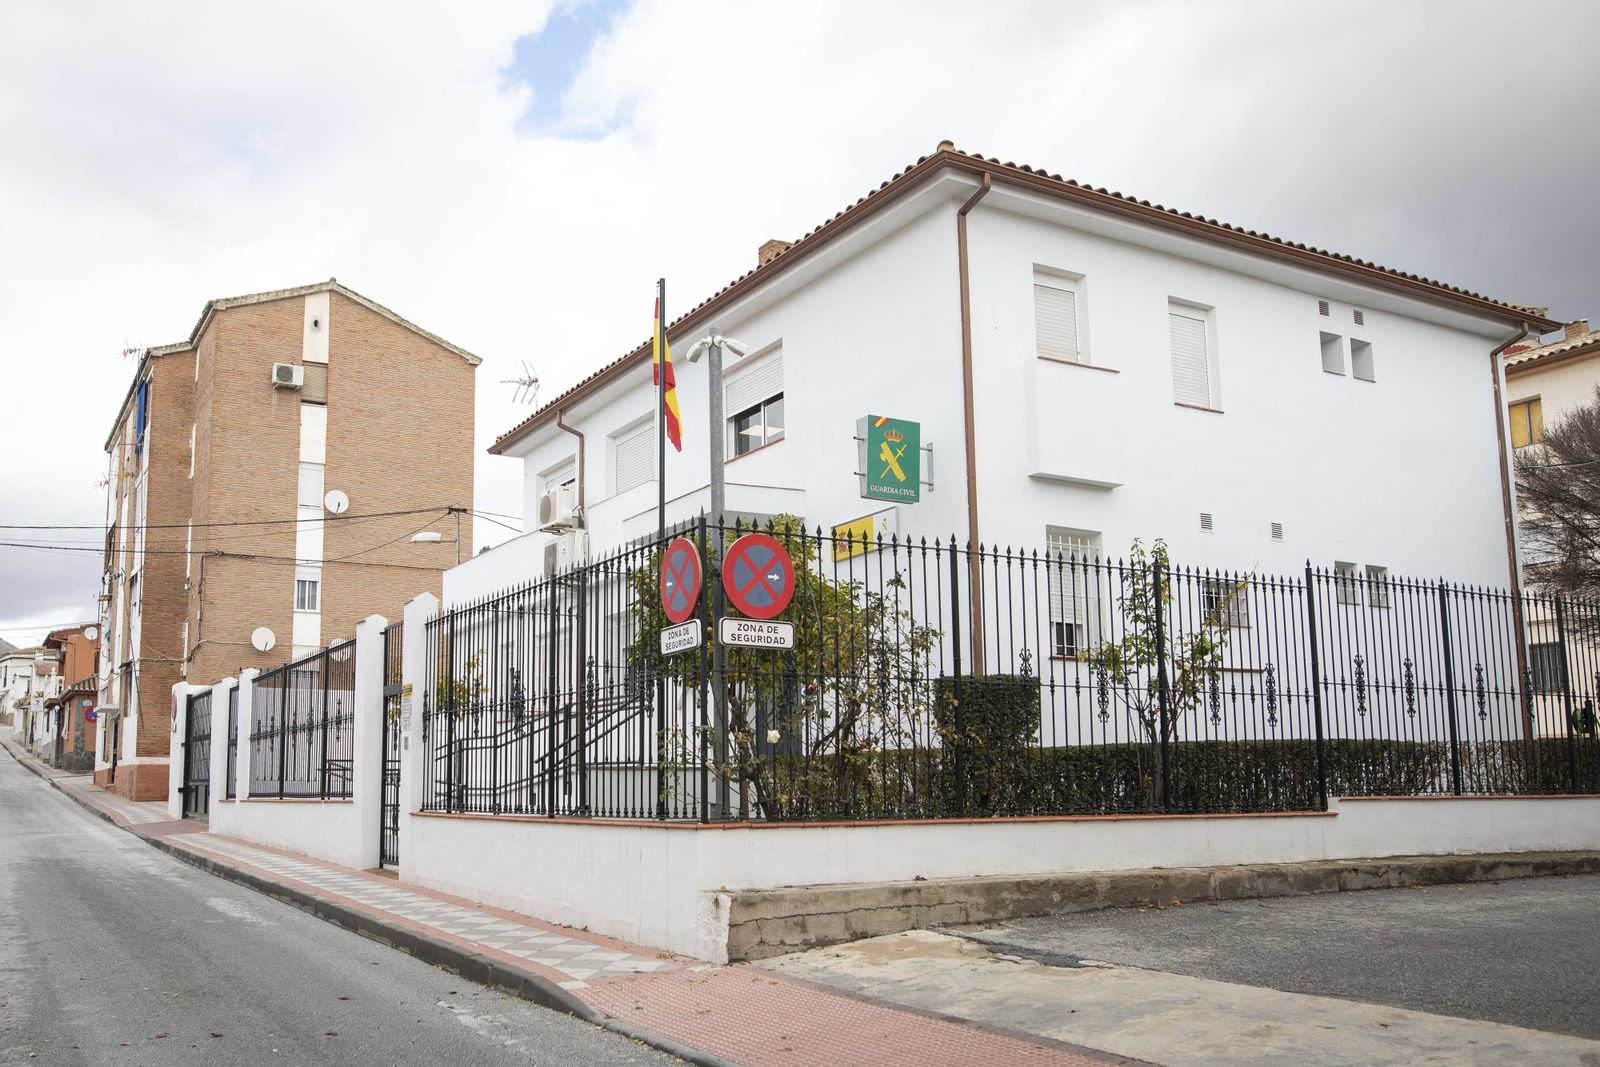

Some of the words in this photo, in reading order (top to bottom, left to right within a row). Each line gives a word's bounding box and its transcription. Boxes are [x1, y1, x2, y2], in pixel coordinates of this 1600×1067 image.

[870, 484, 898, 494] GUARDIA
[899, 488, 916, 496] CIVIL
[668, 630, 682, 639] ZONA
[683, 627, 690, 635] DE
[737, 623, 763, 632] ZONA
[767, 625, 778, 634] DE
[665, 636, 693, 651] SEGURIDAD
[731, 633, 785, 645] SEGURIDAD
